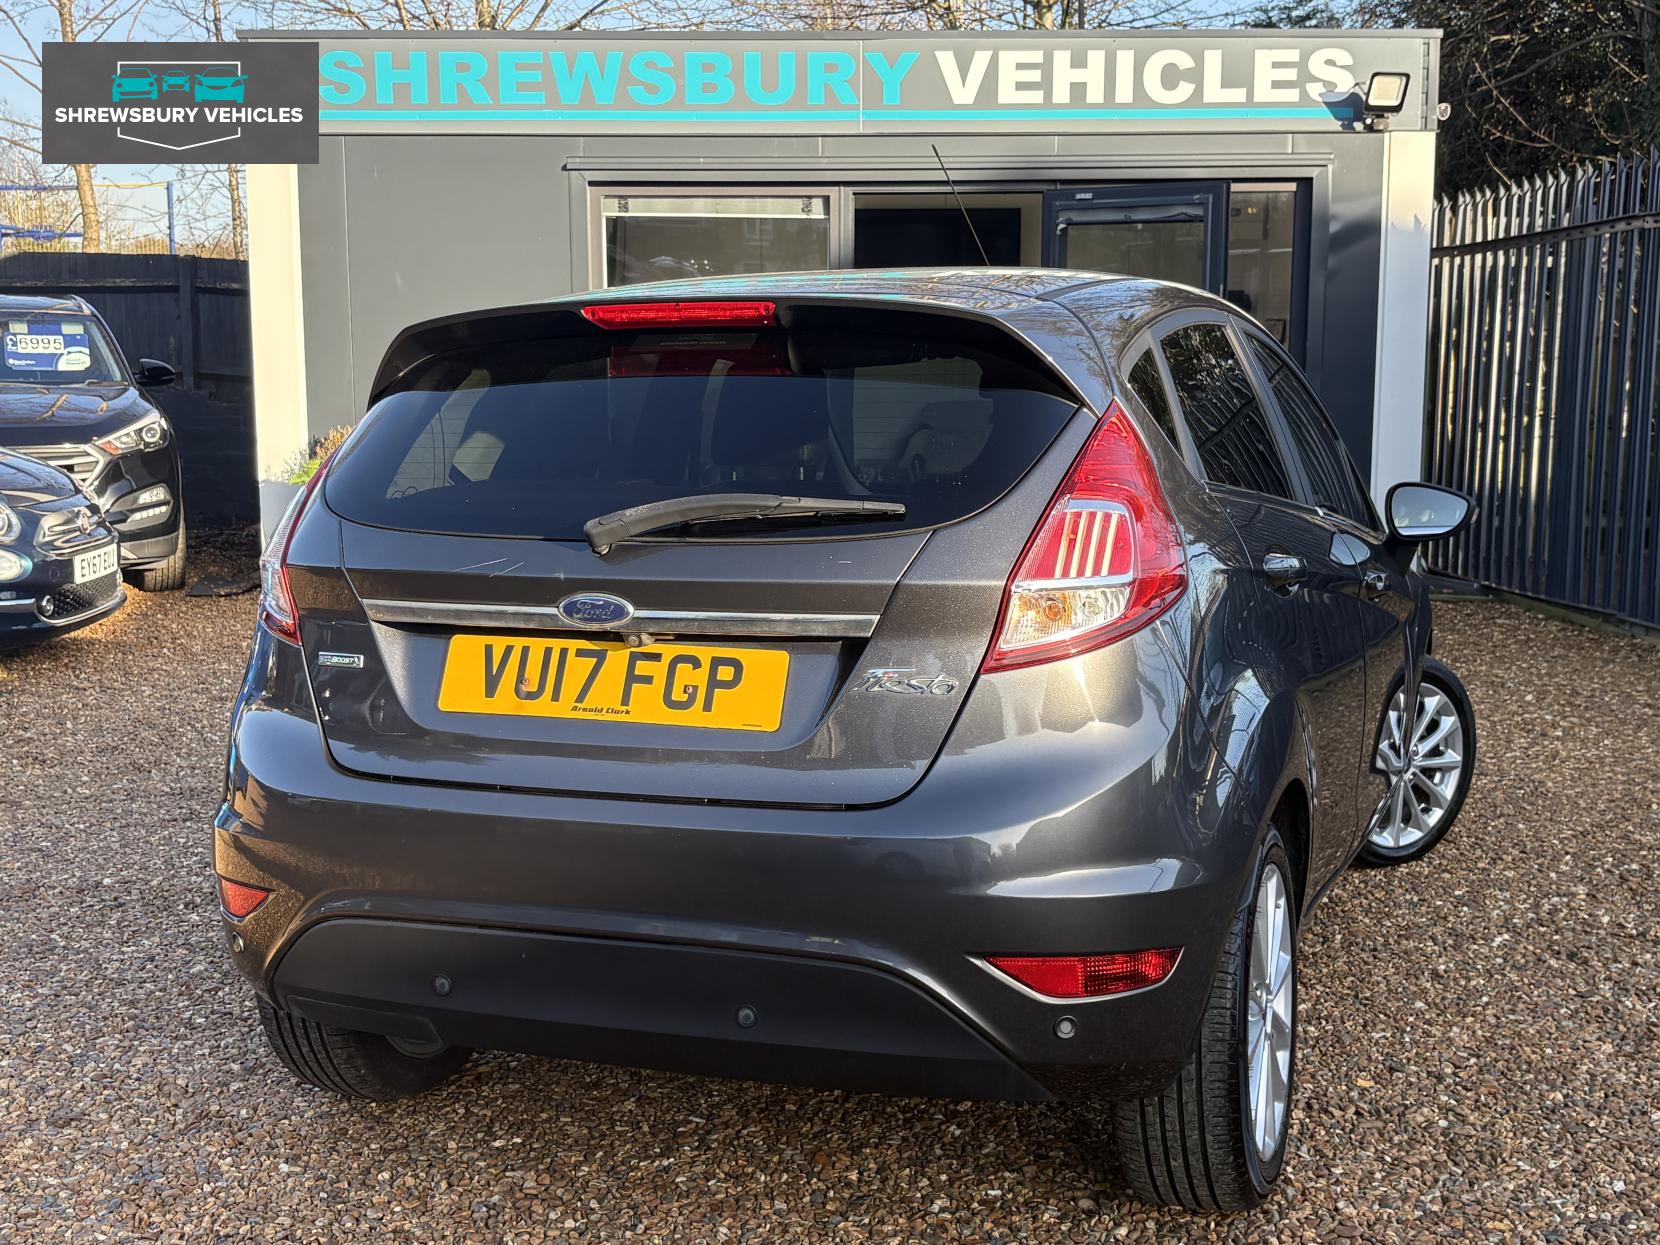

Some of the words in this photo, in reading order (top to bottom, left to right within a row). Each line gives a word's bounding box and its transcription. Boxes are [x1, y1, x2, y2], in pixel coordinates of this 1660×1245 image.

[318, 50, 920, 106] SHREWSBURY
[933, 47, 1356, 105] VEHICLES
[80, 554, 102, 578] EY67
[103, 548, 115, 570] EUJ
[572, 599, 615, 619] Ford
[484, 643, 609, 704] VU17
[620, 651, 745, 713] FGP
[848, 667, 960, 695] Fiesta
[570, 705, 604, 714] Arnold
[605, 707, 632, 716] Clark
